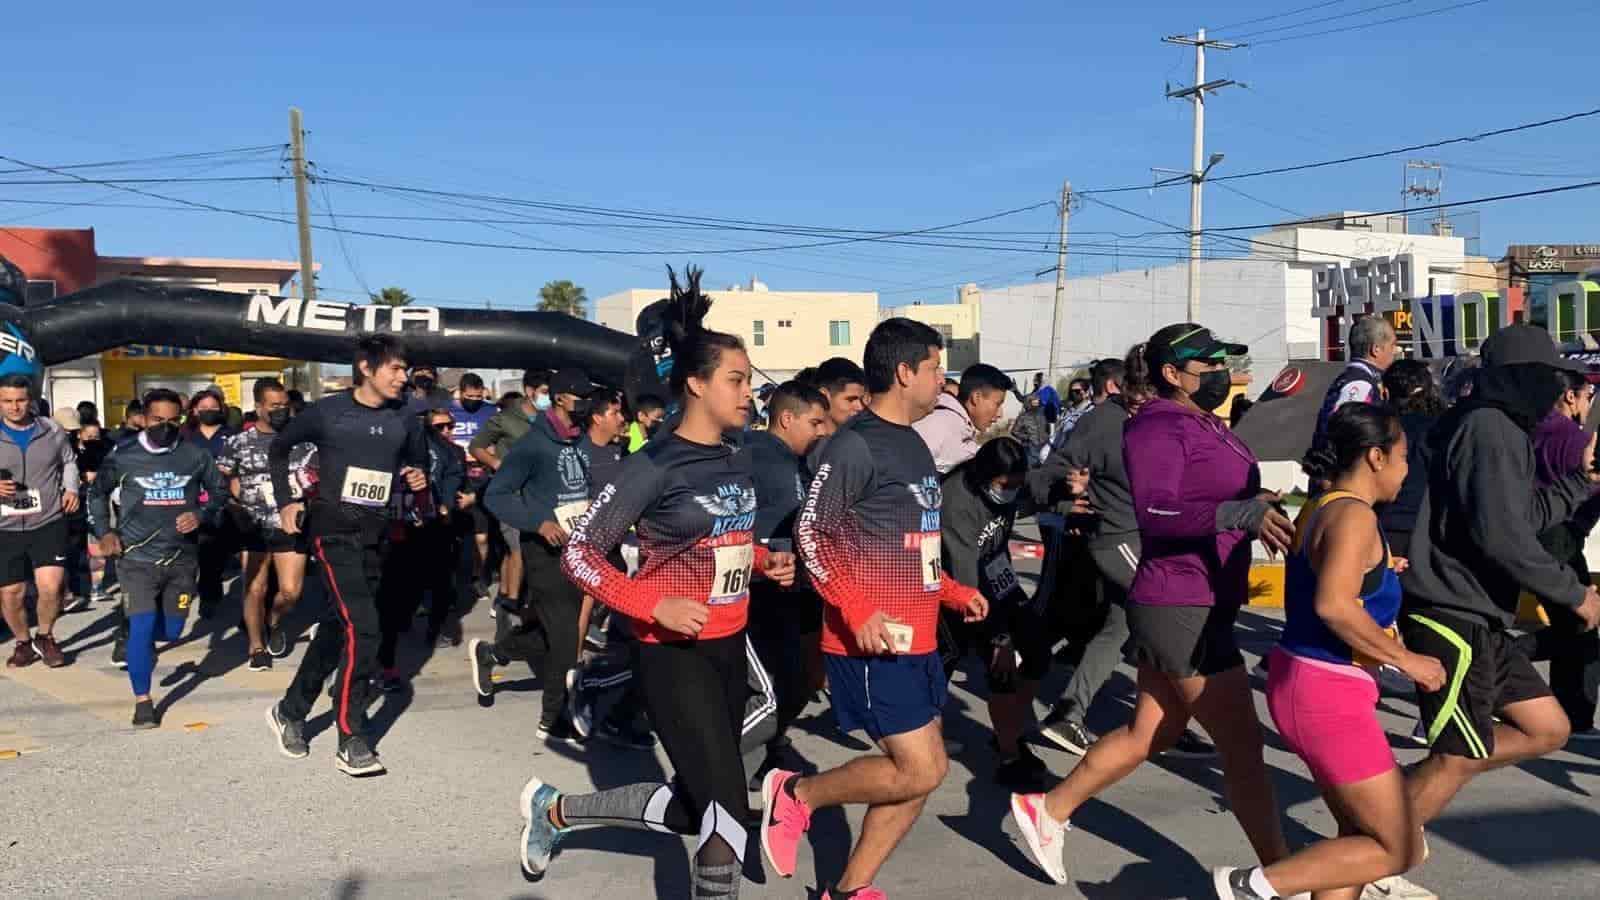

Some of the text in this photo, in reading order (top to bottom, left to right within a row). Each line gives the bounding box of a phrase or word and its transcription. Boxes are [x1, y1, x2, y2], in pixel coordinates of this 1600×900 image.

[247, 294, 440, 332] META
[351, 481, 386, 501] 1680
[718, 483, 741, 497] ALAS
